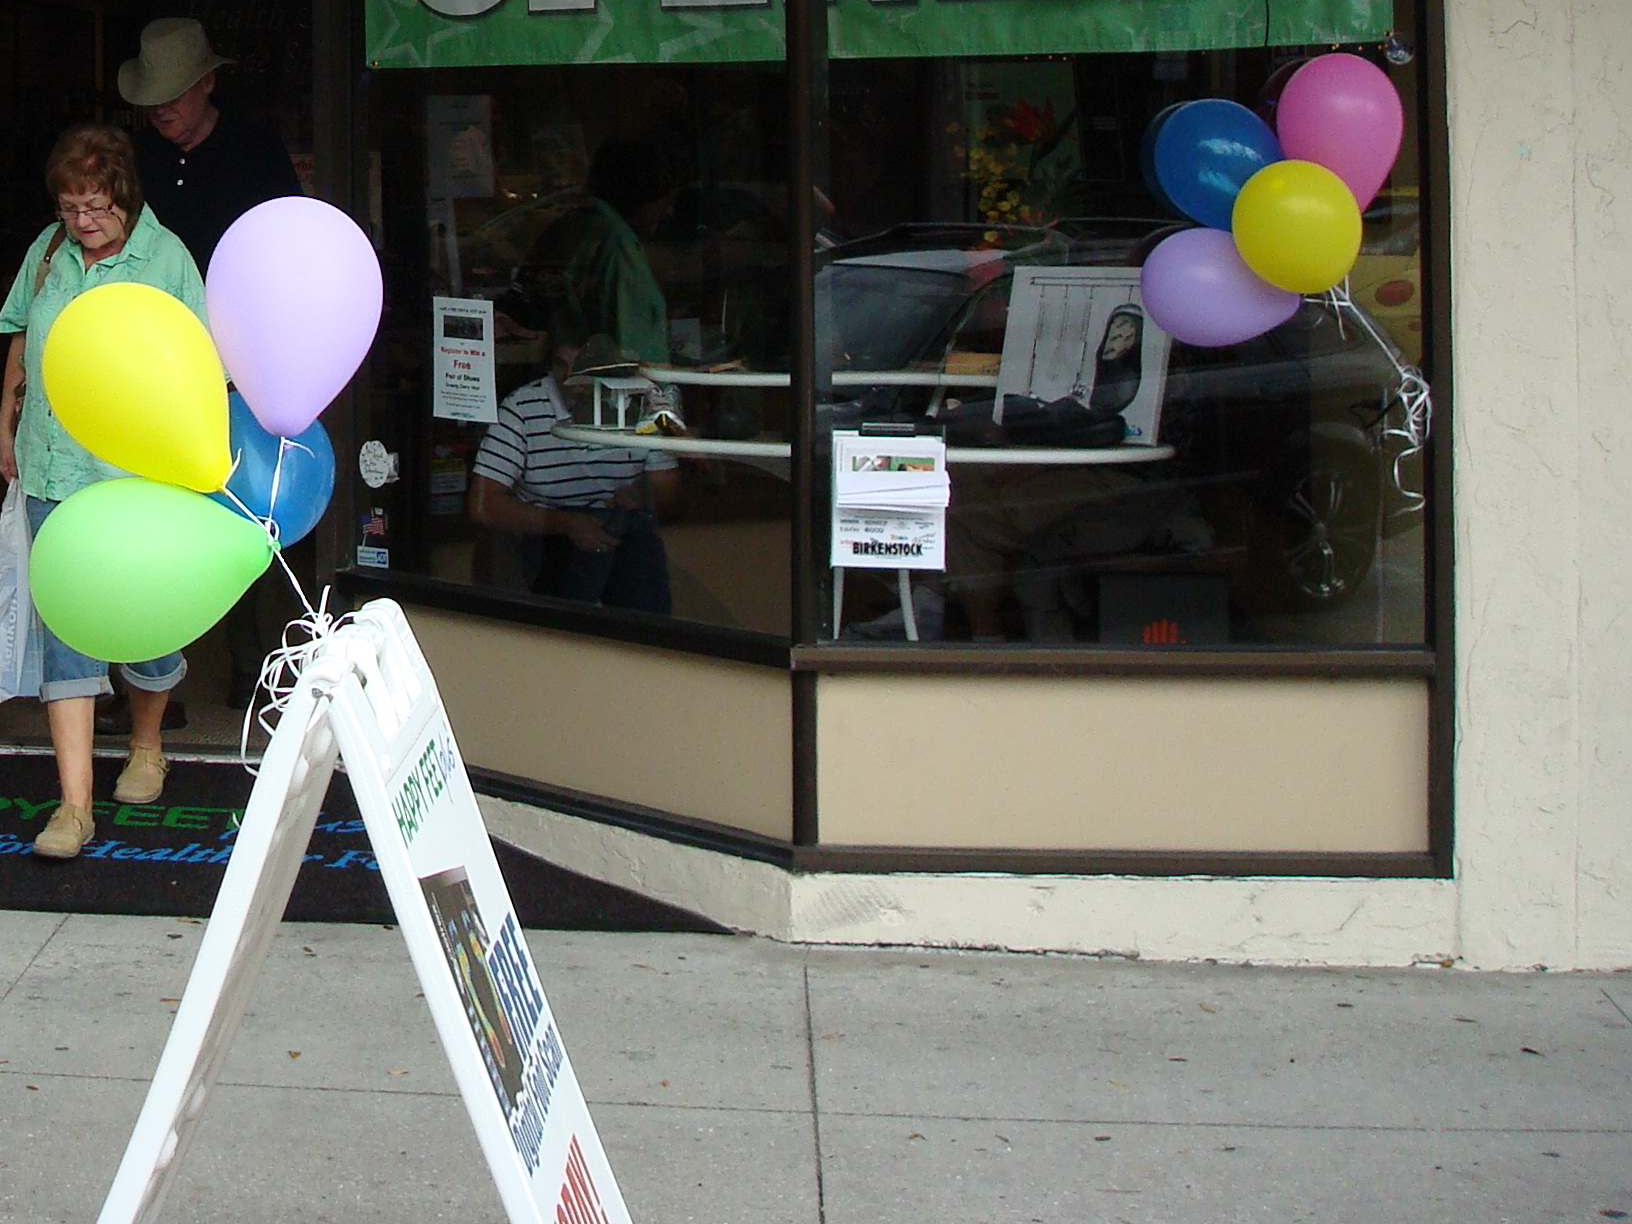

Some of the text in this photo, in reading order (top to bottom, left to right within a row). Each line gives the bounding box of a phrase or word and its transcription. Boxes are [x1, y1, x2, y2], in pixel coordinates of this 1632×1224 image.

[852, 541, 923, 556] BIRKENSTOCK
[391, 764, 430, 850] HAPPY
[418, 737, 447, 806] FEET
[487, 910, 544, 1062] FREE
